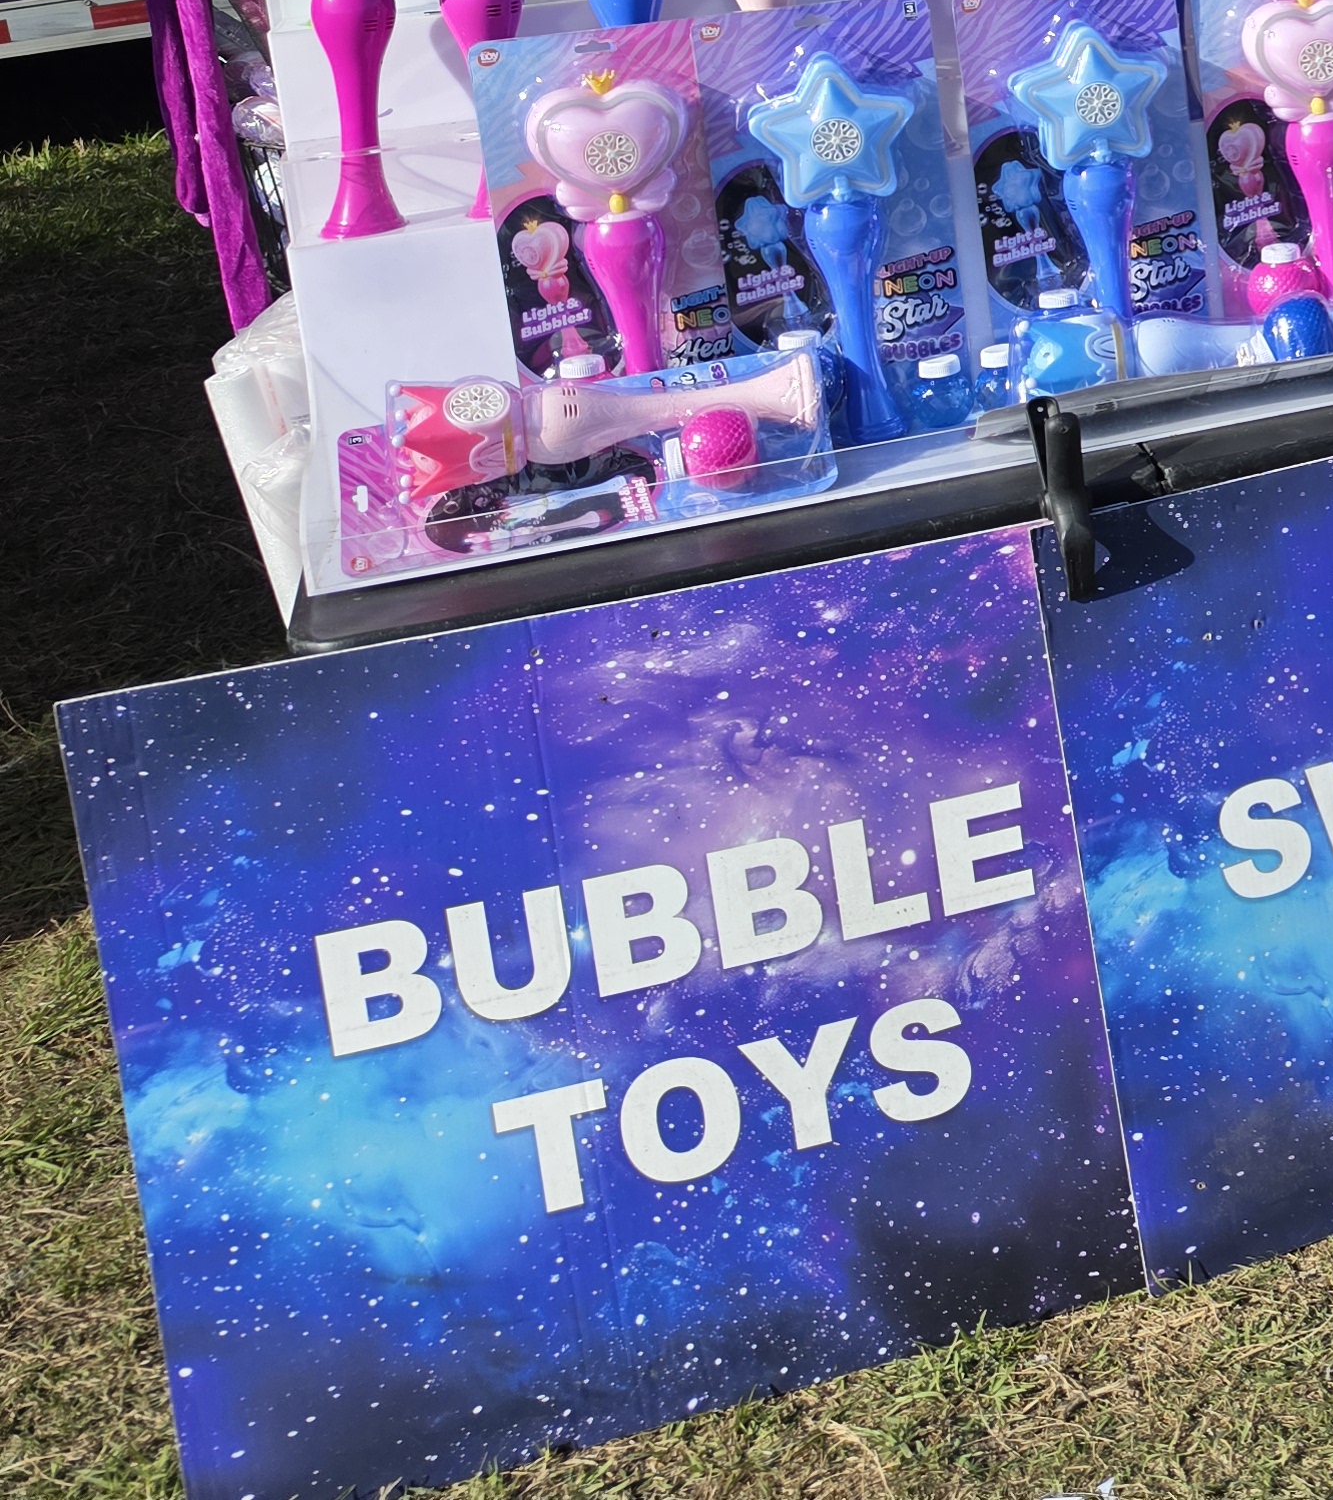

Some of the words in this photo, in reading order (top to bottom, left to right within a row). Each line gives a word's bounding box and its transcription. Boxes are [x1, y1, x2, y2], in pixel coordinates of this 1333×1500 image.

[905, 3, 914, 13] 3
[701, 25, 721, 37] toy
[479, 50, 499, 62] toy
[1223, 203, 1280, 229] Bubbles!
[1225, 196, 1249, 214] Light
[1132, 212, 1194, 239] IGHT-UP
[993, 238, 1056, 265] Bubbles!
[995, 232, 1024, 251] Light
[1130, 232, 1197, 257] NEON
[877, 248, 952, 279] LIGHT-UP
[736, 274, 806, 304] Bubbles!
[737, 268, 771, 289] Light
[884, 269, 955, 295] NEON
[1130, 257, 1190, 301] Star
[671, 284, 727, 311] LIGHT-
[520, 308, 592, 340] Bubbles!
[522, 302, 557, 324] Light
[675, 305, 731, 330] NEO
[880, 296, 950, 340] Star
[626, 498, 640, 524] Light
[640, 477, 657, 523] Bubbles!
[315, 781, 1036, 1057] BUBBLE
[493, 999, 972, 1213] TOYS
